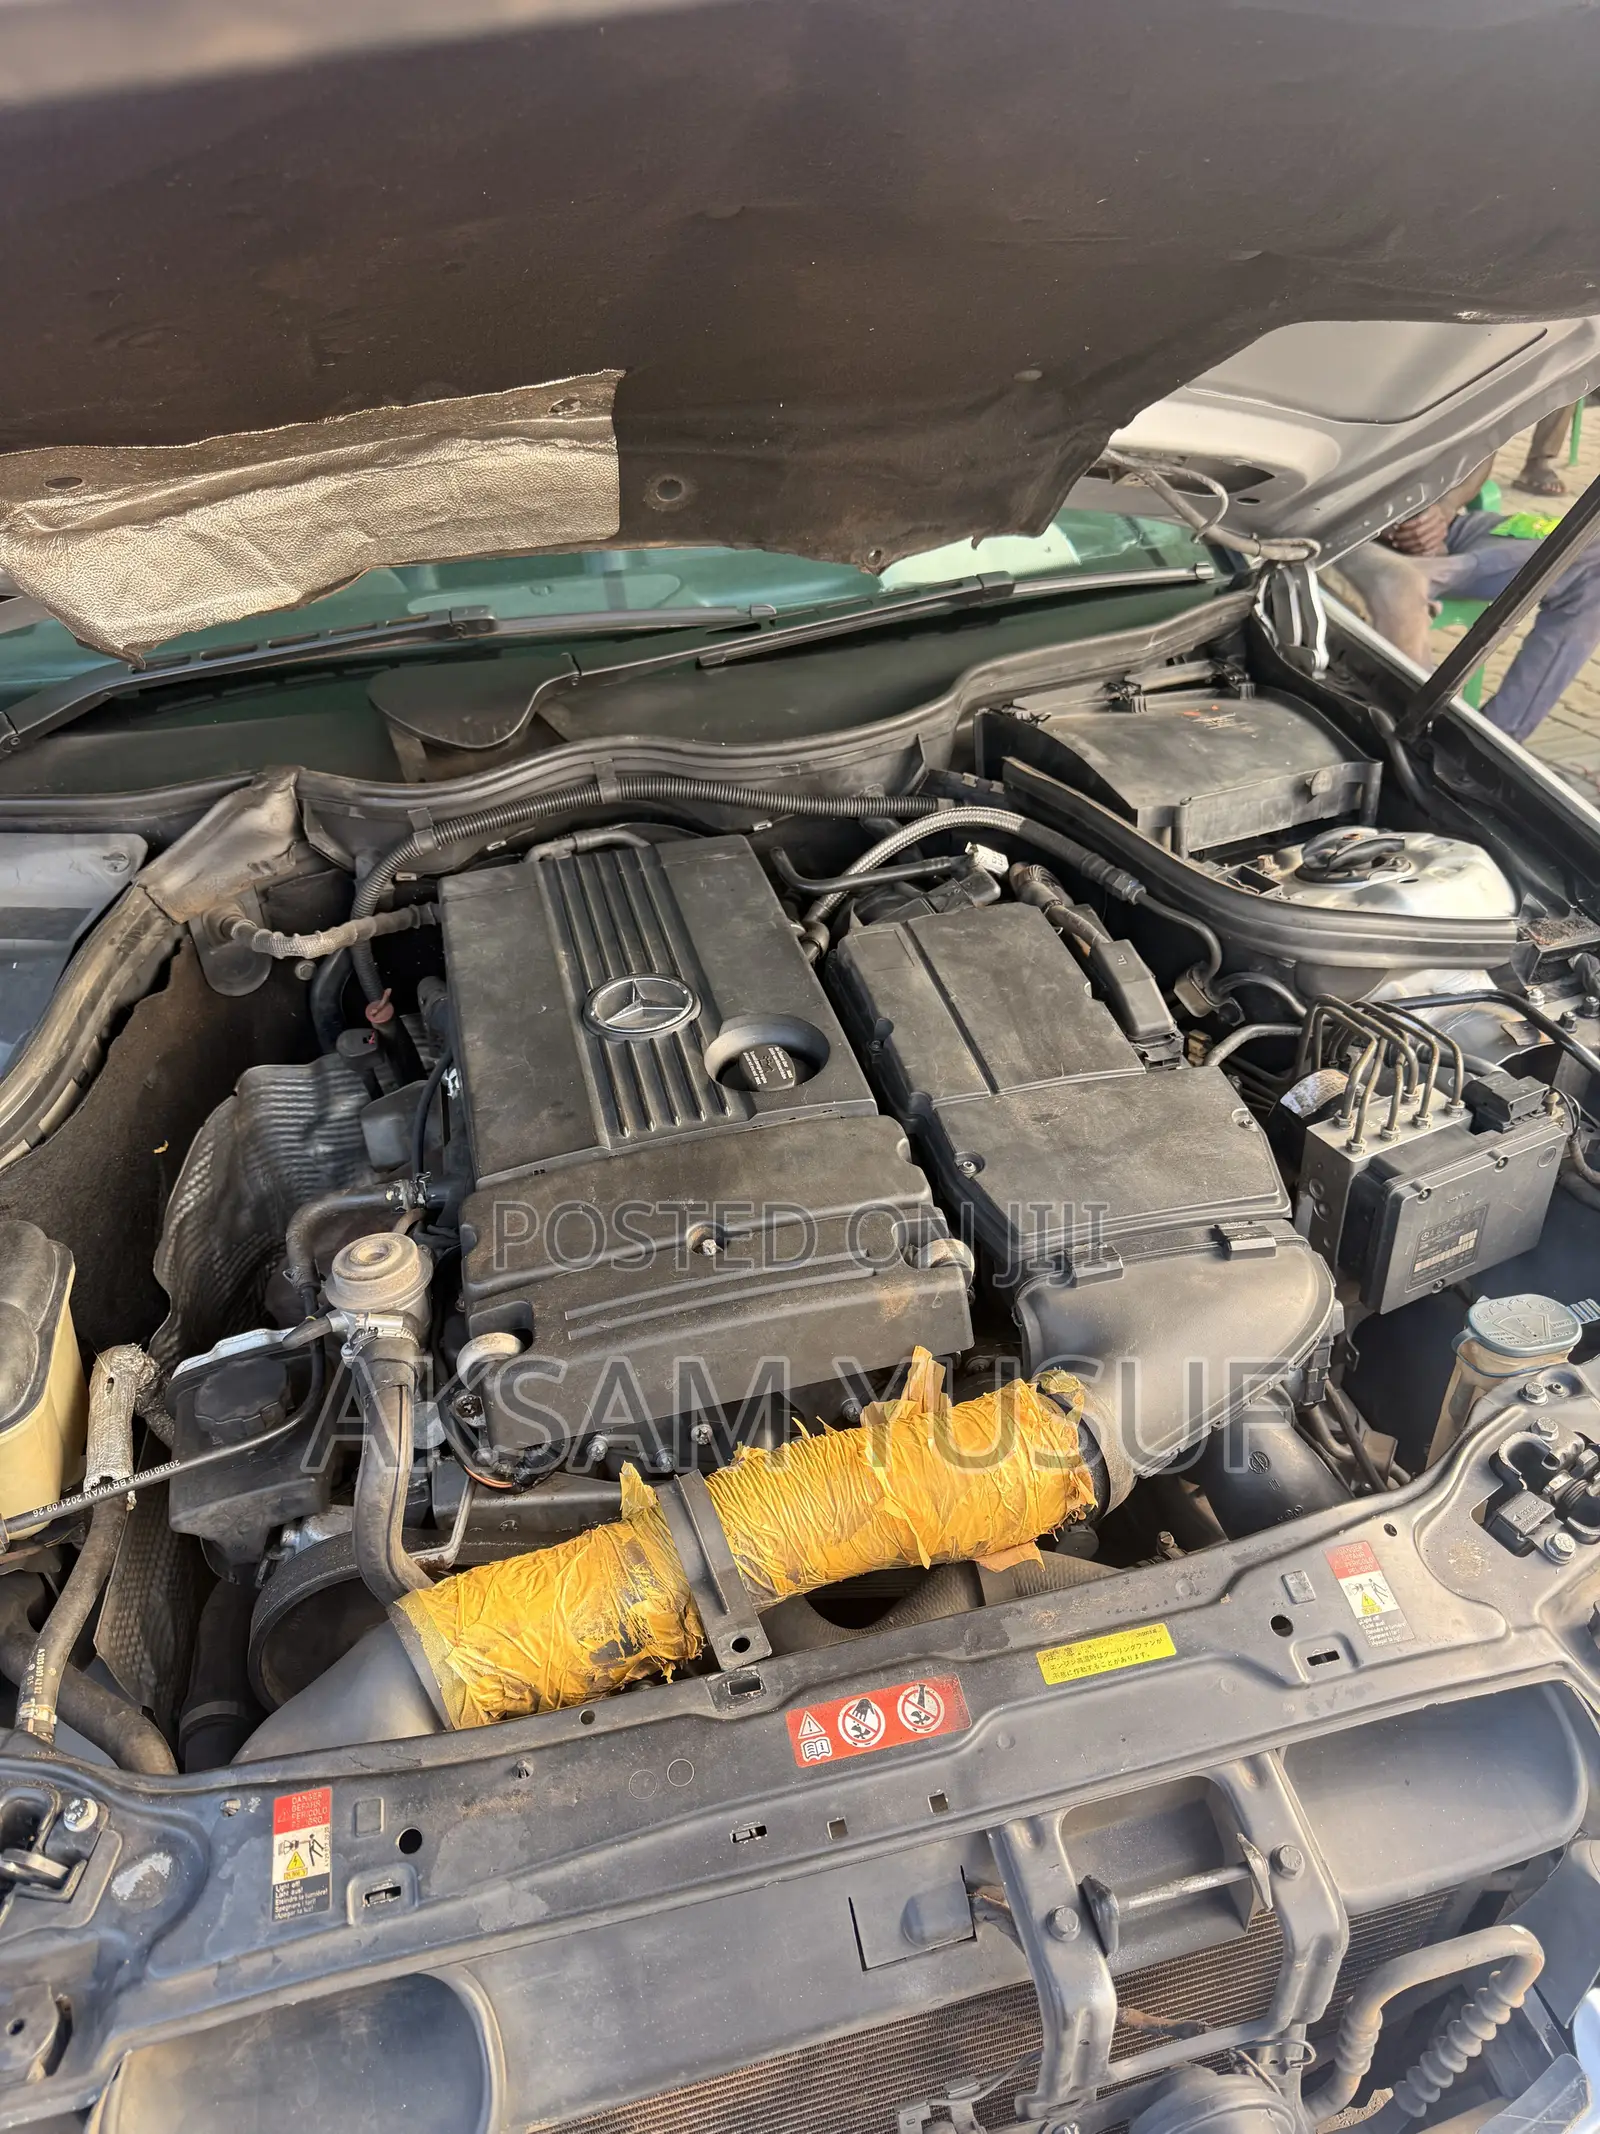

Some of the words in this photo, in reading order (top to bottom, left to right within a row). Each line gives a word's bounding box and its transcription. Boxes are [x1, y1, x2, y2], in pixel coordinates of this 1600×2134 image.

[128, 1459, 181, 1485] 2035010025
[84, 1480, 127, 1501] BRYMAN
[32, 1495, 82, 1518] 2021.09.26
[291, 1791, 323, 1805] DANGER
